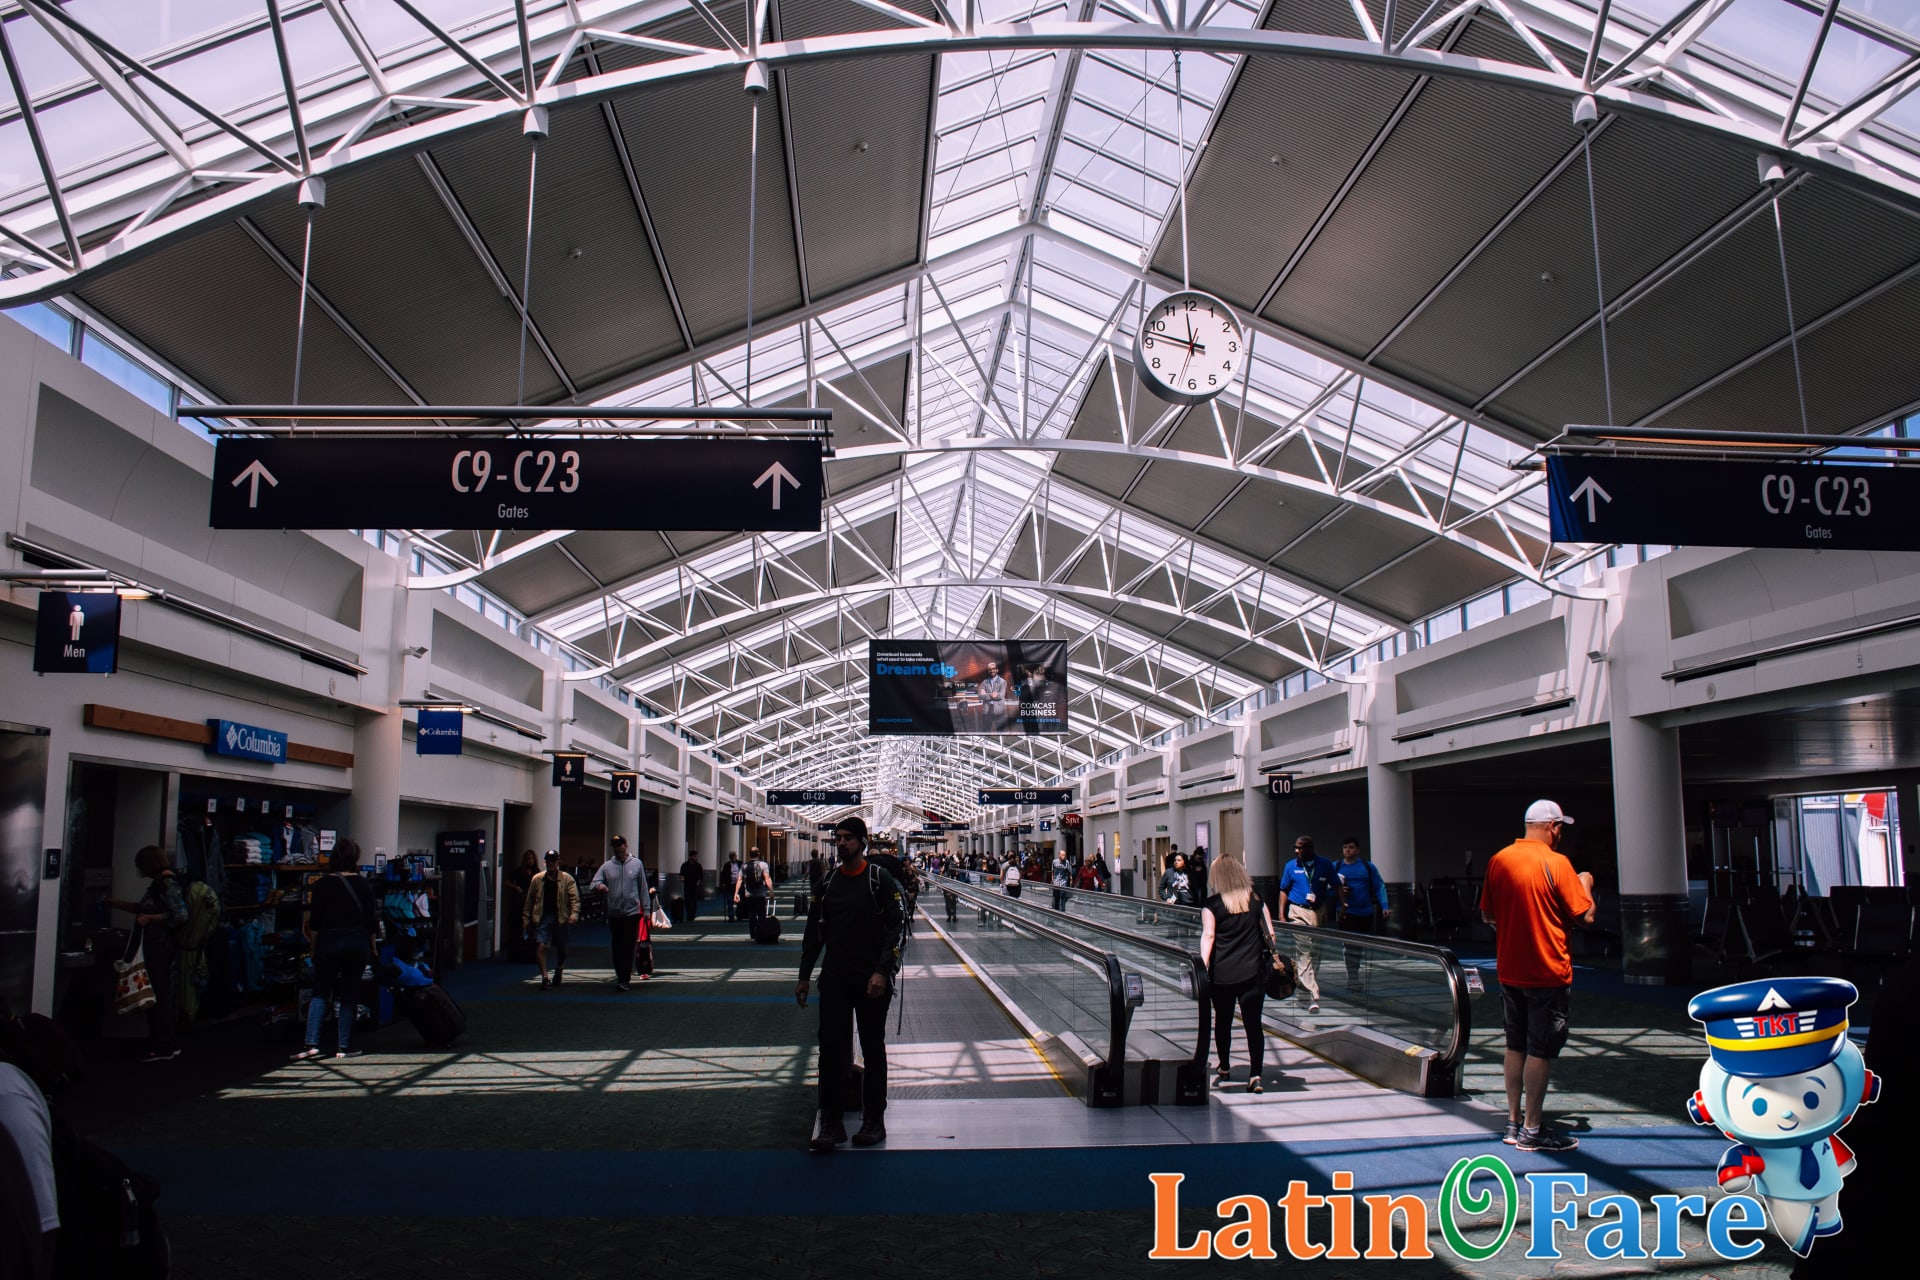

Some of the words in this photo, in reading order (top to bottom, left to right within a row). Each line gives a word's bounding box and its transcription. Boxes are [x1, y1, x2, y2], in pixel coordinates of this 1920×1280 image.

[1164, 306, 1176, 316] 11
[1183, 300, 1197, 312] 12
[1208, 307, 1214, 318] 1
[1150, 320, 1166, 332] 10
[1222, 322, 1230, 332] 2
[1145, 338, 1154, 348] 9
[1228, 342, 1236, 352] 3
[1152, 358, 1160, 368] 8
[1222, 360, 1231, 371] 4
[1168, 374, 1176, 384] 7
[1188, 379, 1196, 390] 6
[1208, 374, 1216, 385] 5
[452, 450, 580, 493] C9-C23
[1762, 474, 1872, 516] C9-C23
[498, 504, 528, 518] Gates
[1806, 524, 1832, 539] Gates
[64, 644, 86, 658] Men
[876, 664, 926, 675] Dream
[930, 662, 958, 678] Gig.
[238, 728, 280, 756] Columbia
[618, 780, 630, 793] C9
[1272, 780, 1290, 793] C10
[1014, 792, 1037, 800] C11-C23
